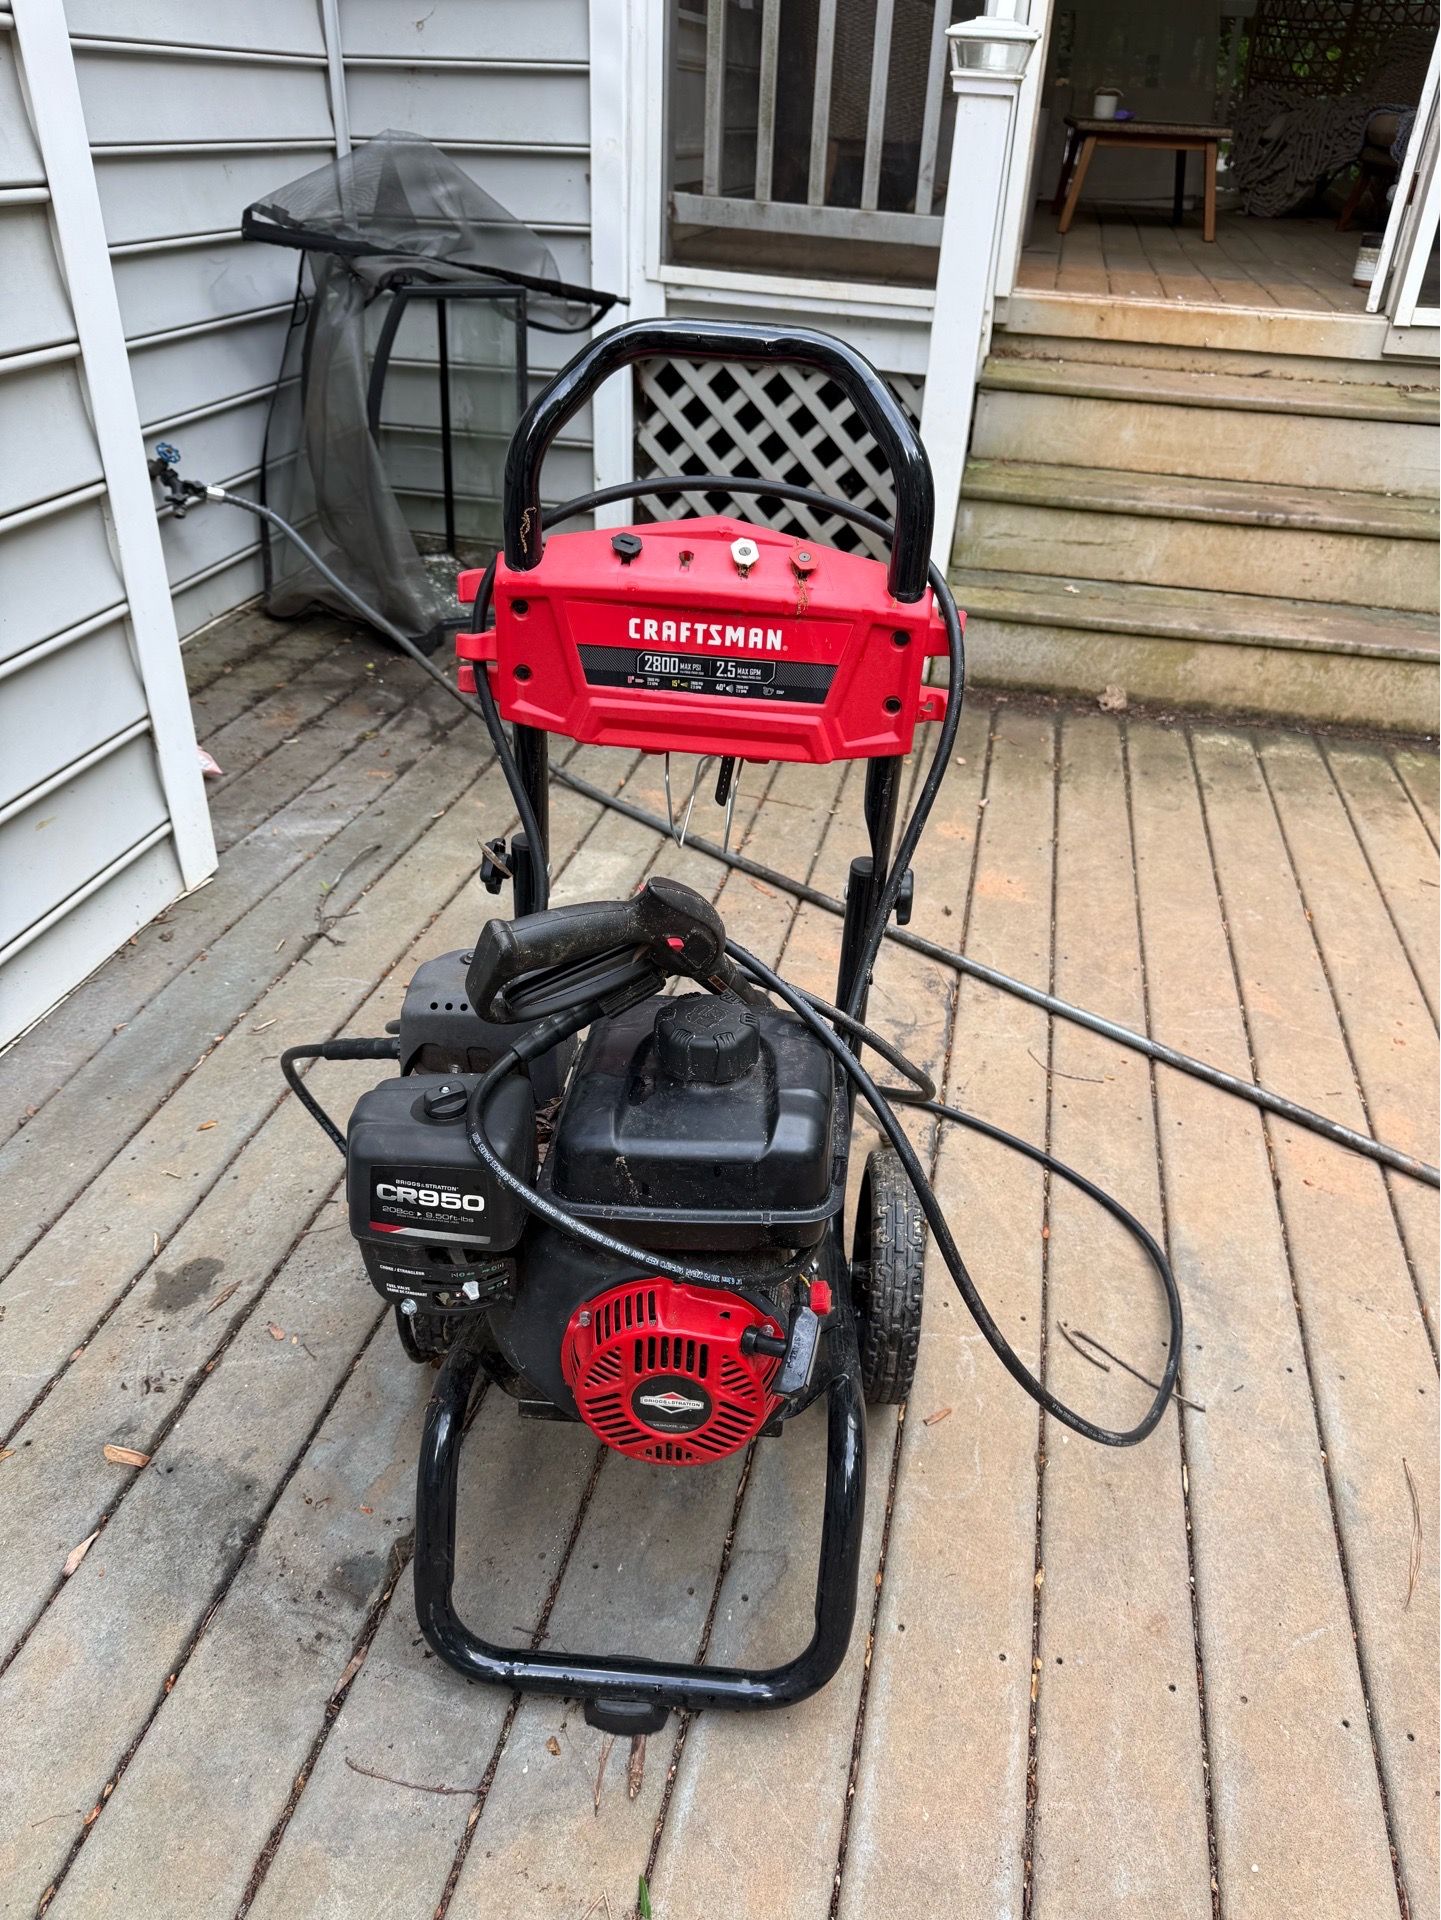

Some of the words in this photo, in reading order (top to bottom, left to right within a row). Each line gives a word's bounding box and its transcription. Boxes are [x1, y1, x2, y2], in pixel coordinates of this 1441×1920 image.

[628, 617, 783, 651] CRAFTSMAN
[644, 655, 679, 673] 2800
[716, 661, 736, 678] 2.5
[737, 667, 749, 675] MAX
[750, 668, 762, 676] GPM
[376, 1183, 485, 1212] CR950
[382, 1205, 415, 1216] 208cc
[602, 1238, 615, 1249] HOT
[614, 1243, 631, 1256] FROM
[630, 1249, 646, 1261] AWAY
[645, 1255, 659, 1267] KEEP
